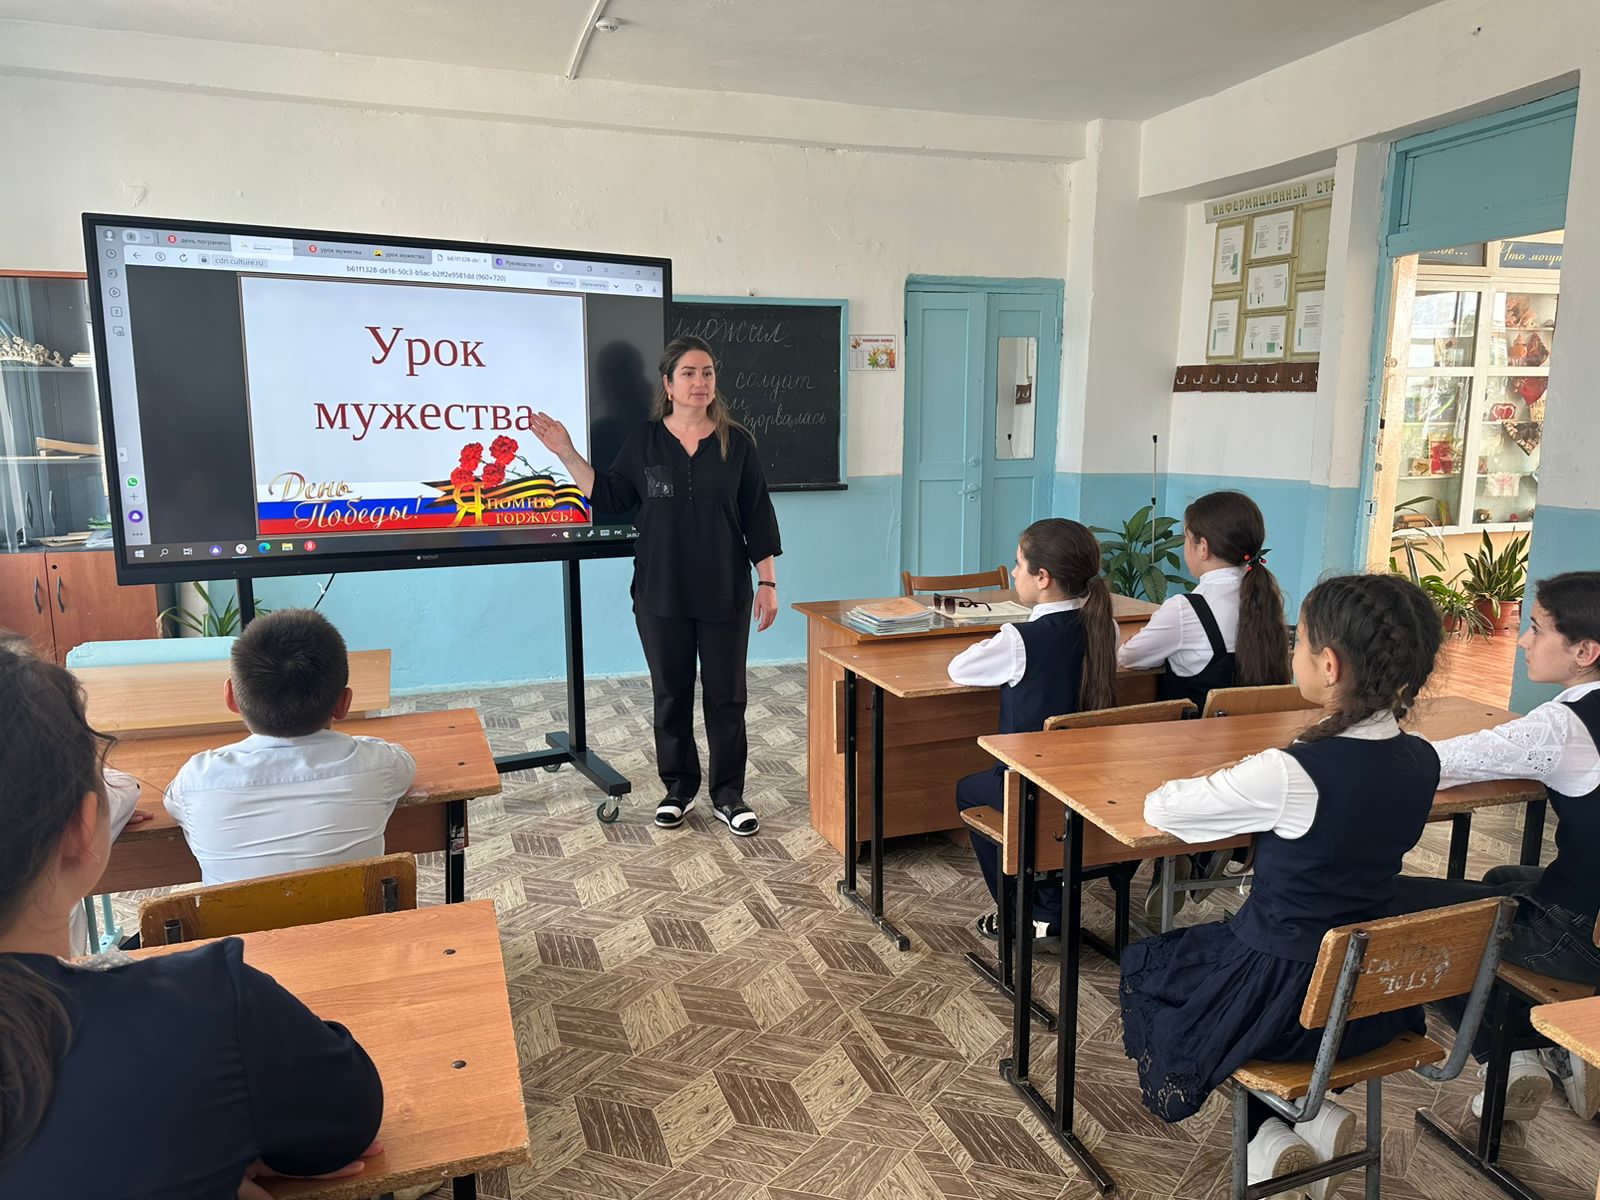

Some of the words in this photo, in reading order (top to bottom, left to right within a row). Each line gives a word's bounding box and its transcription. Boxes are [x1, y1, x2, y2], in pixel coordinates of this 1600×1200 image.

[1212, 183, 1308, 216] ИНФОРМАЦИОННЫЙ
[215, 256, 264, 267] cdn.culture.ru
[1498, 240, 1526, 262] Что
[365, 326, 486, 377] Урок
[313, 402, 533, 441] мужества
[268, 471, 354, 502] День
[293, 494, 424, 529] Победы!
[448, 482, 488, 528] Я
[495, 506, 575, 526] горжусь!
